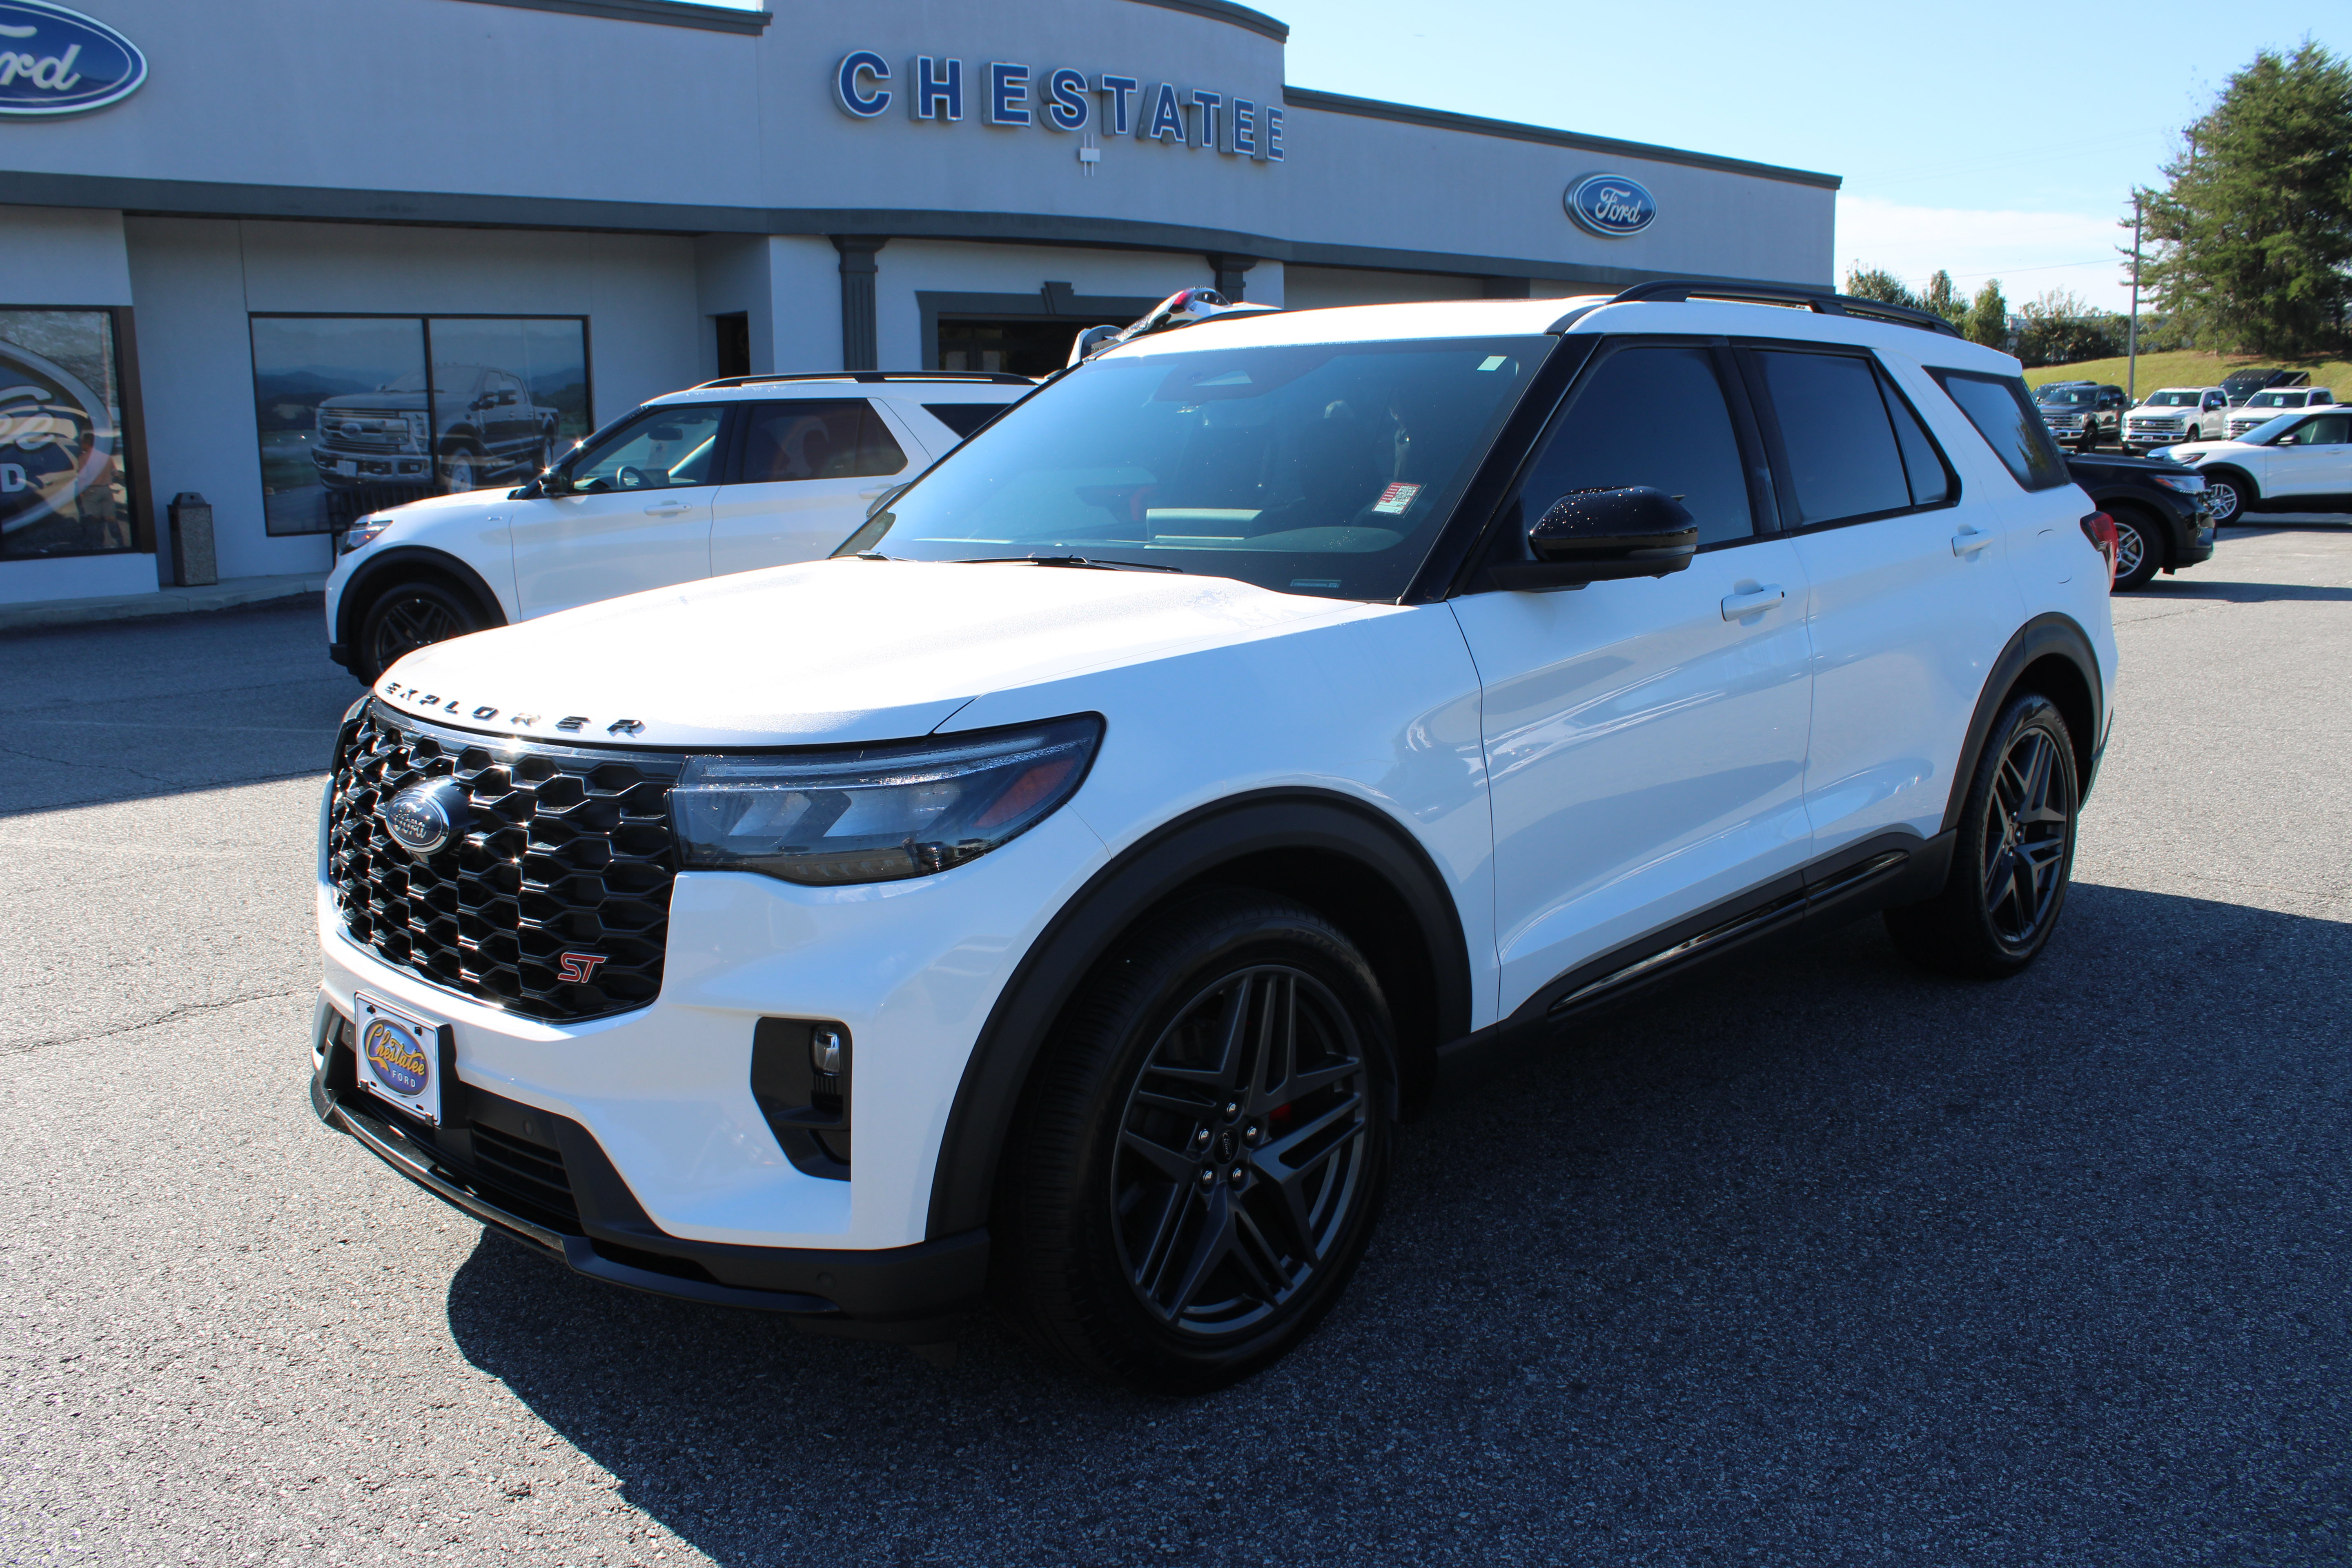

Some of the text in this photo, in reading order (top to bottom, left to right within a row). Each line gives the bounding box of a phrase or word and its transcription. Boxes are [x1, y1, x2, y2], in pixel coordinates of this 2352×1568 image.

[834, 50, 1285, 162] CHESTATEE
[1595, 187, 1642, 223] Ford
[385, 682, 646, 737] EXPLORER
[392, 802, 427, 839] Ford
[557, 952, 608, 983] ST
[367, 1023, 426, 1076] Chestatee
[392, 1069, 416, 1088] FORD
